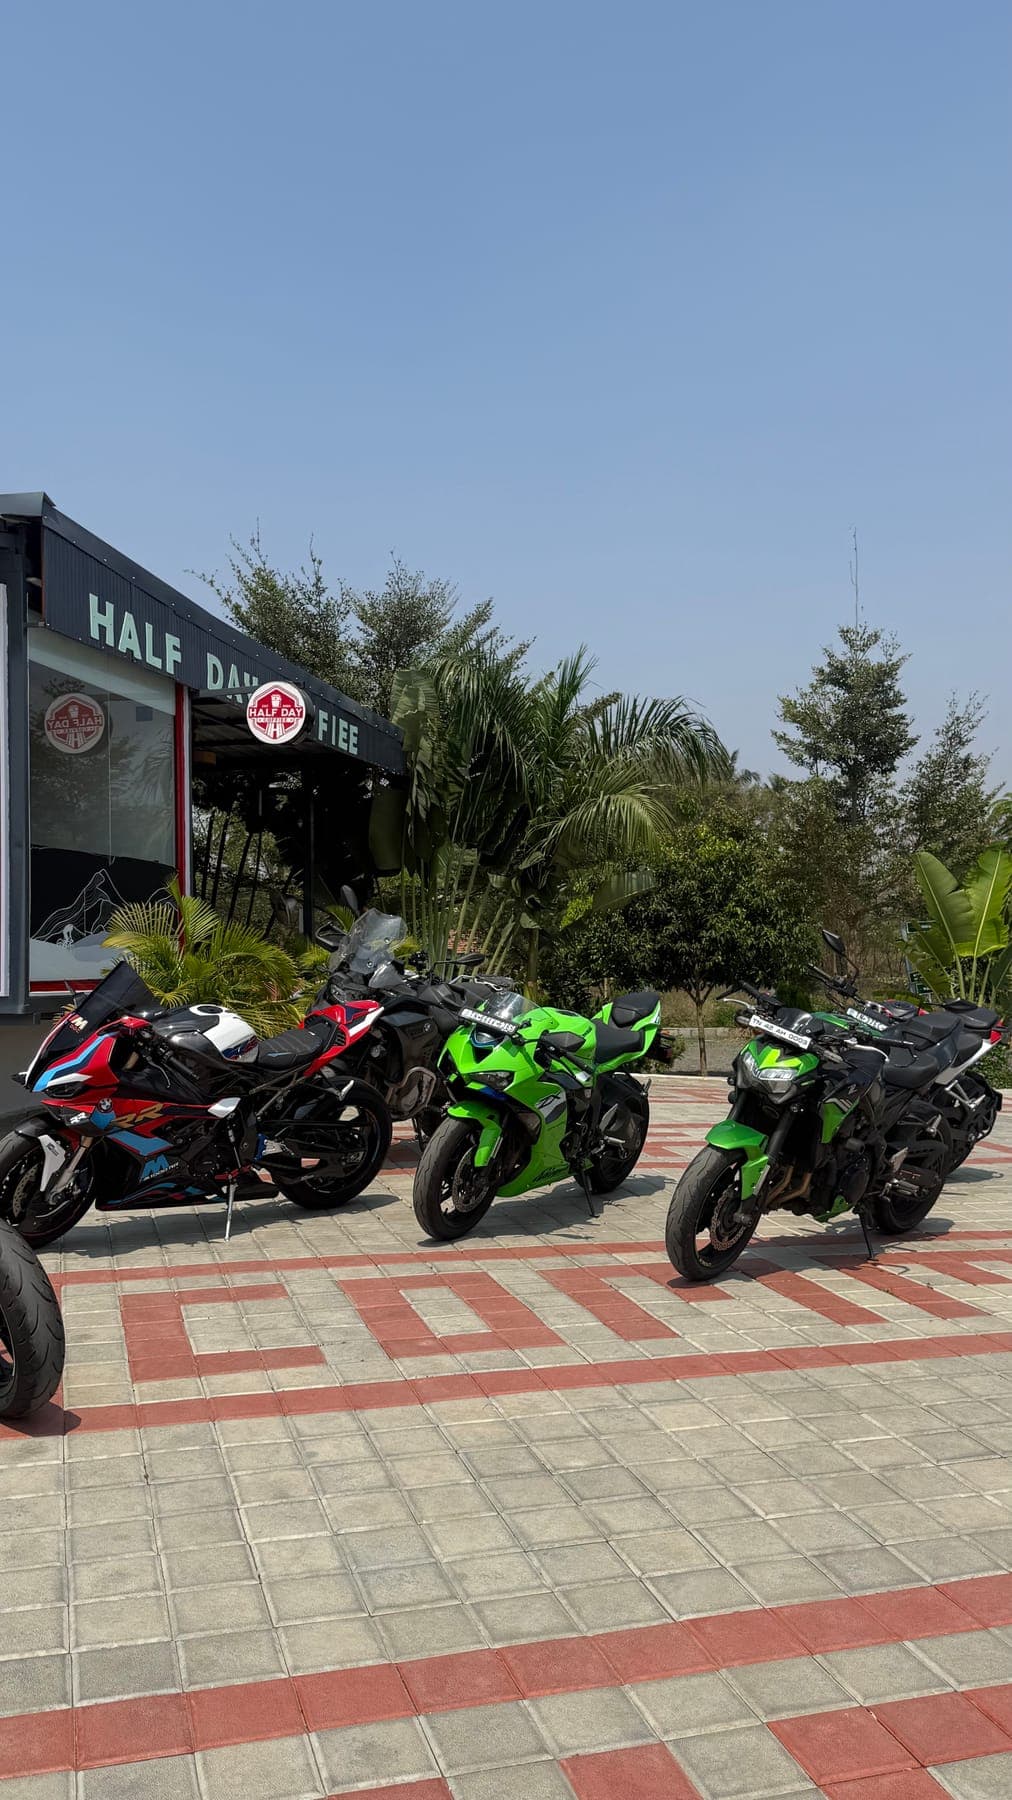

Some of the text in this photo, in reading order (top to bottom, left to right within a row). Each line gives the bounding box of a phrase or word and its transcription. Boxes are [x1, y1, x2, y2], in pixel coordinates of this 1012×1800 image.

[89, 592, 182, 676] HALF
[313, 705, 359, 756] FIEE
[249, 708, 303, 717] HALF DAY
